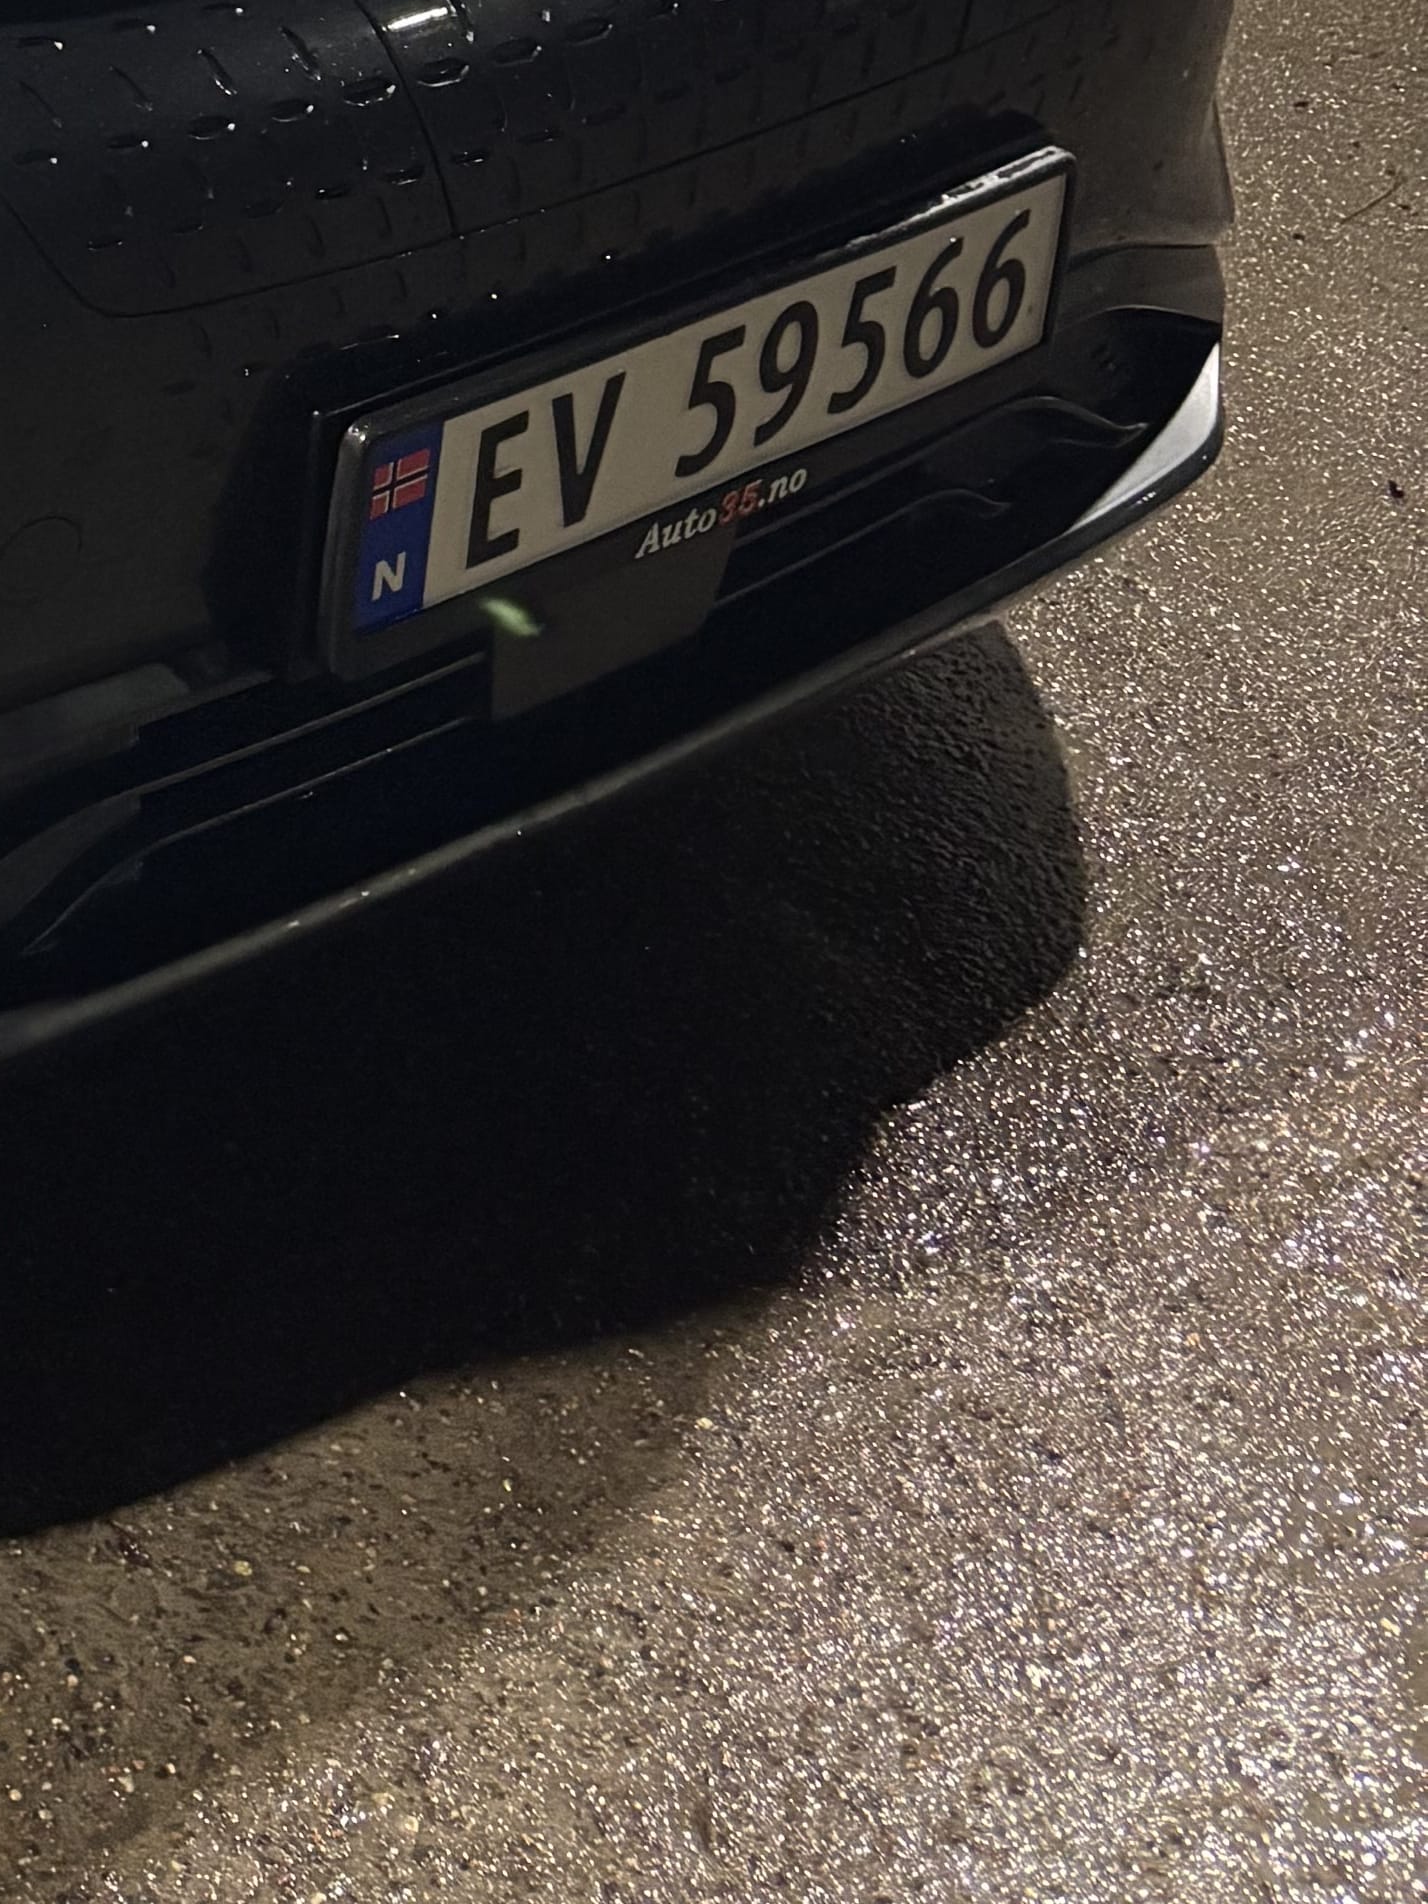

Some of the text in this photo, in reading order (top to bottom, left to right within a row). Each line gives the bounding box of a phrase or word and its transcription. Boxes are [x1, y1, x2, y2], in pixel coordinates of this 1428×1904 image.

[466, 210, 1030, 569] EV 59566
[371, 550, 407, 601] N
